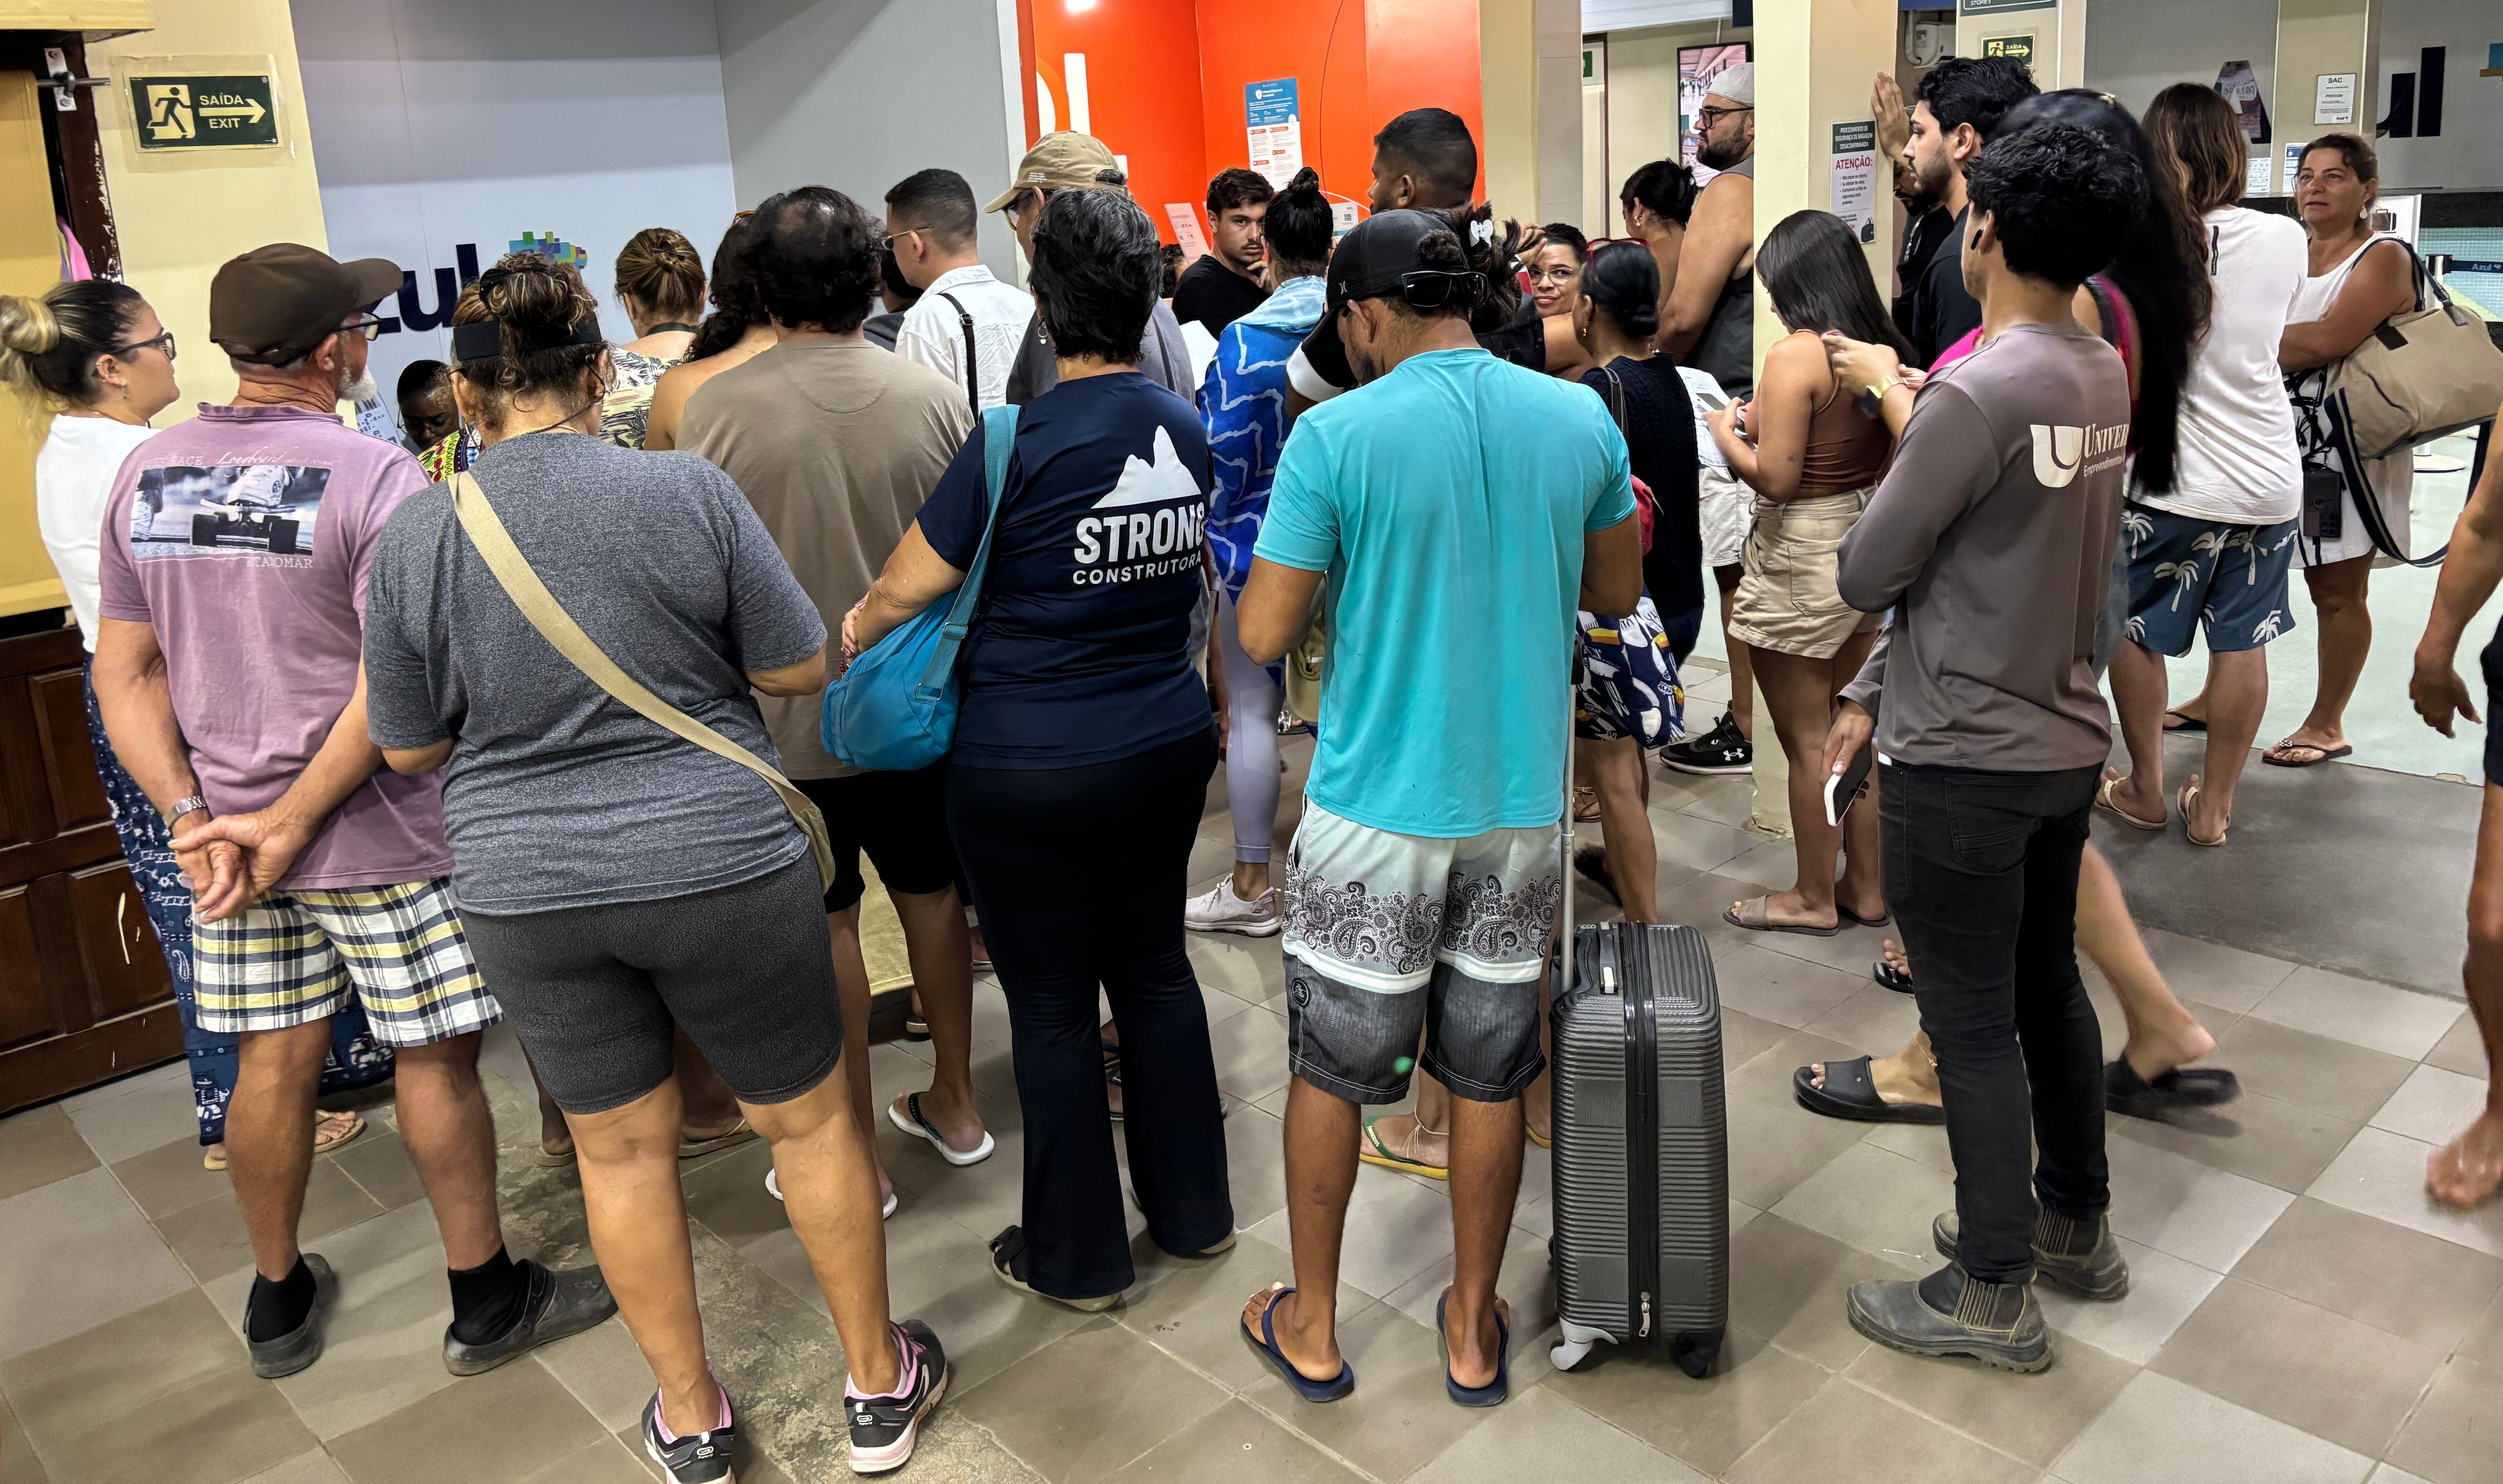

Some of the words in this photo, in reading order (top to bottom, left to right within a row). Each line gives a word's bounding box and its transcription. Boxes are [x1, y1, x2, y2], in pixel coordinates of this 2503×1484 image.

[199, 92, 244, 105] SAÍDA
[209, 118, 240, 129] EXIT
[1836, 155, 1872, 170] ATENÇÃO:
[1074, 502, 1208, 564] STRONG
[1073, 550, 1201, 585] CONSTRUTORA
